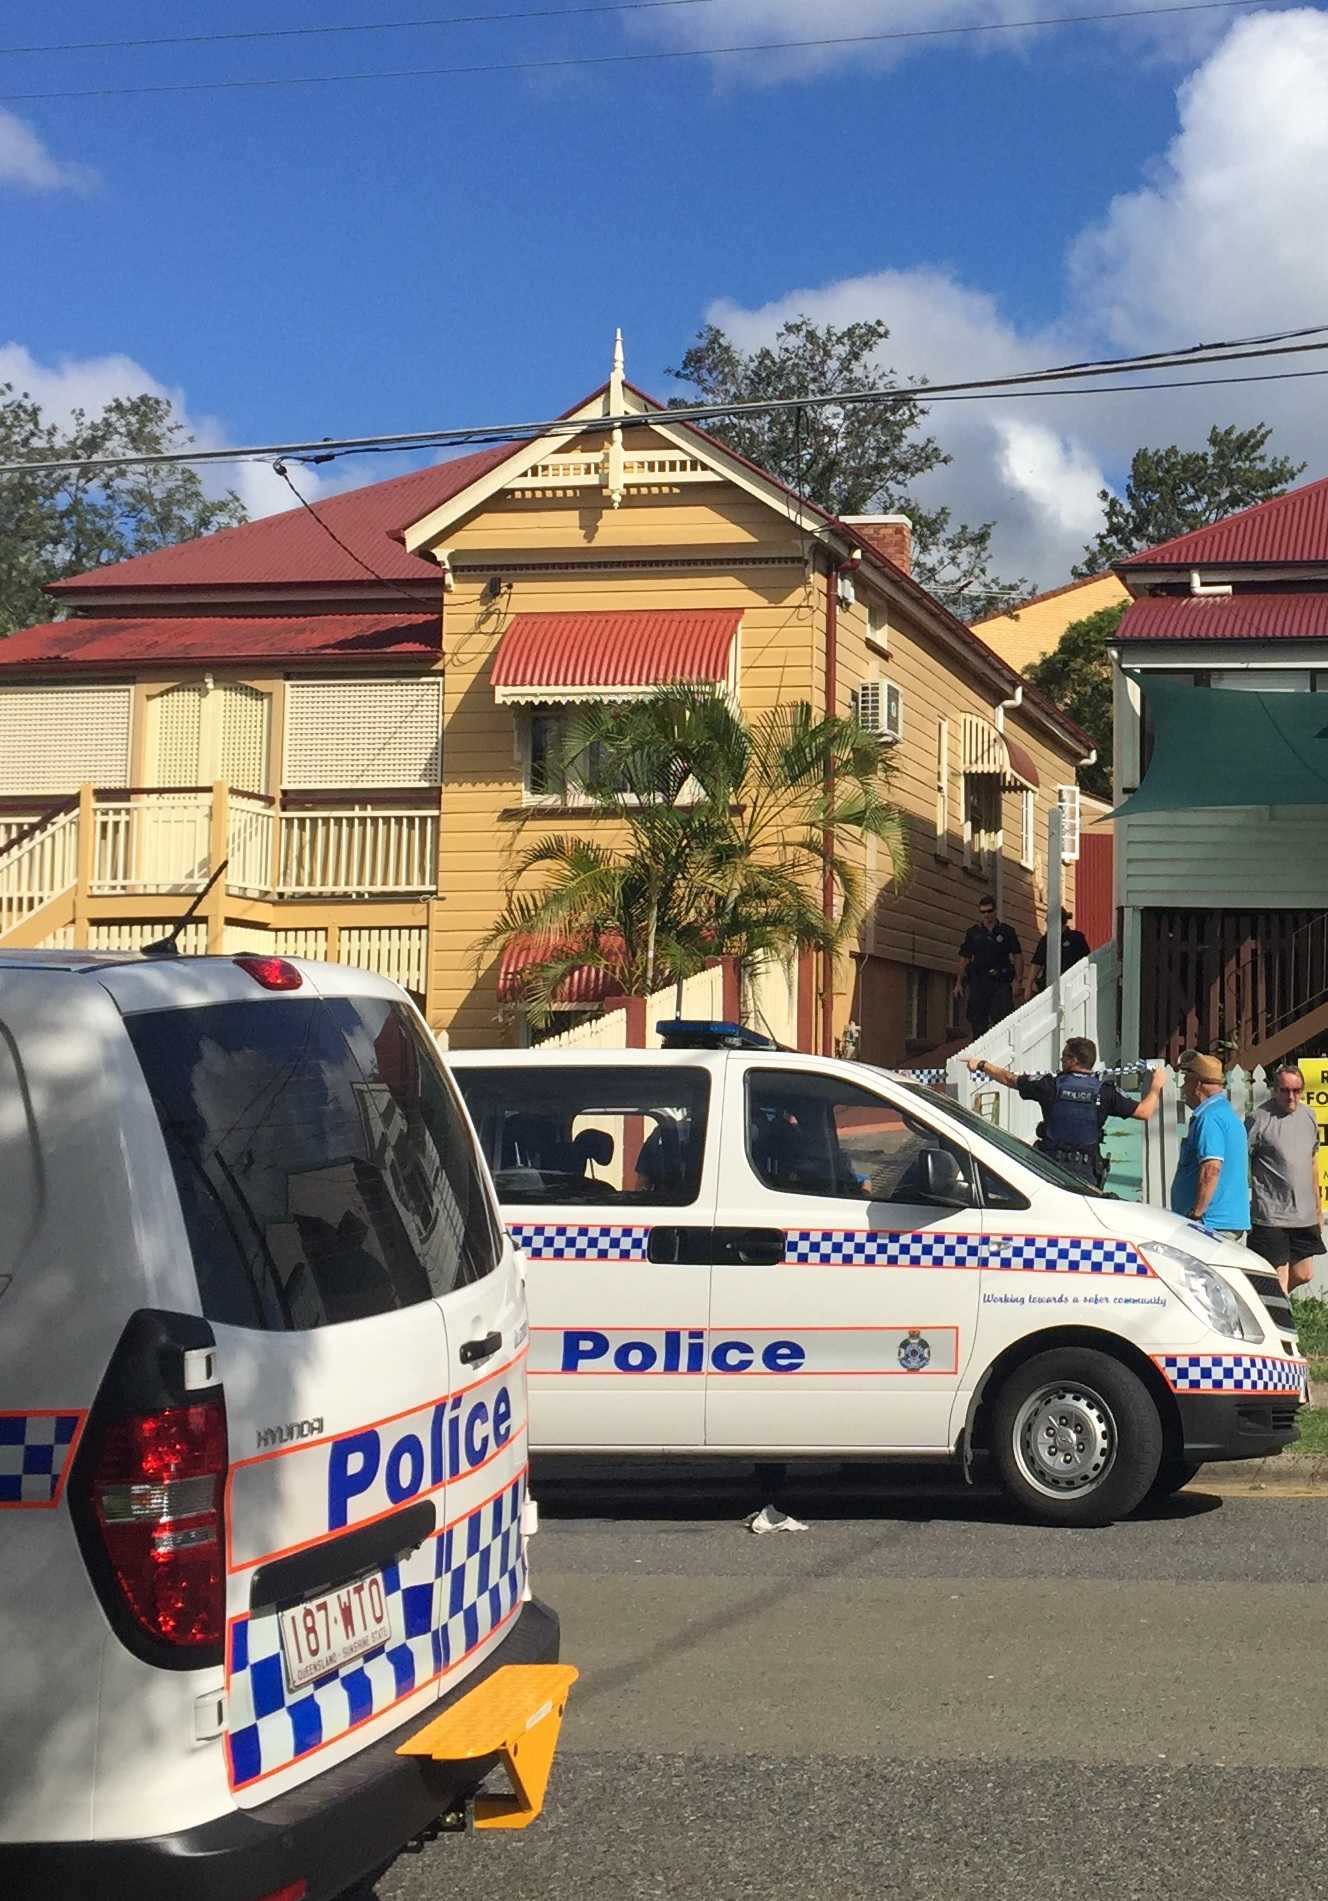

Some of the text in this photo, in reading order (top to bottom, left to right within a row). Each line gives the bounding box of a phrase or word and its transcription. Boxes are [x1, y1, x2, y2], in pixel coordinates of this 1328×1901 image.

[1062, 1090, 1093, 1100] POLICE
[982, 1292, 1025, 1306] Working
[1028, 1292, 1069, 1304] towards
[1083, 1293, 1110, 1305] safer
[1113, 1295, 1167, 1308] community
[561, 1331, 806, 1373] Police
[255, 1416, 324, 1449] HYUNDAI
[328, 1386, 512, 1532] Police
[297, 1652, 337, 1681] QUEENSLAND
